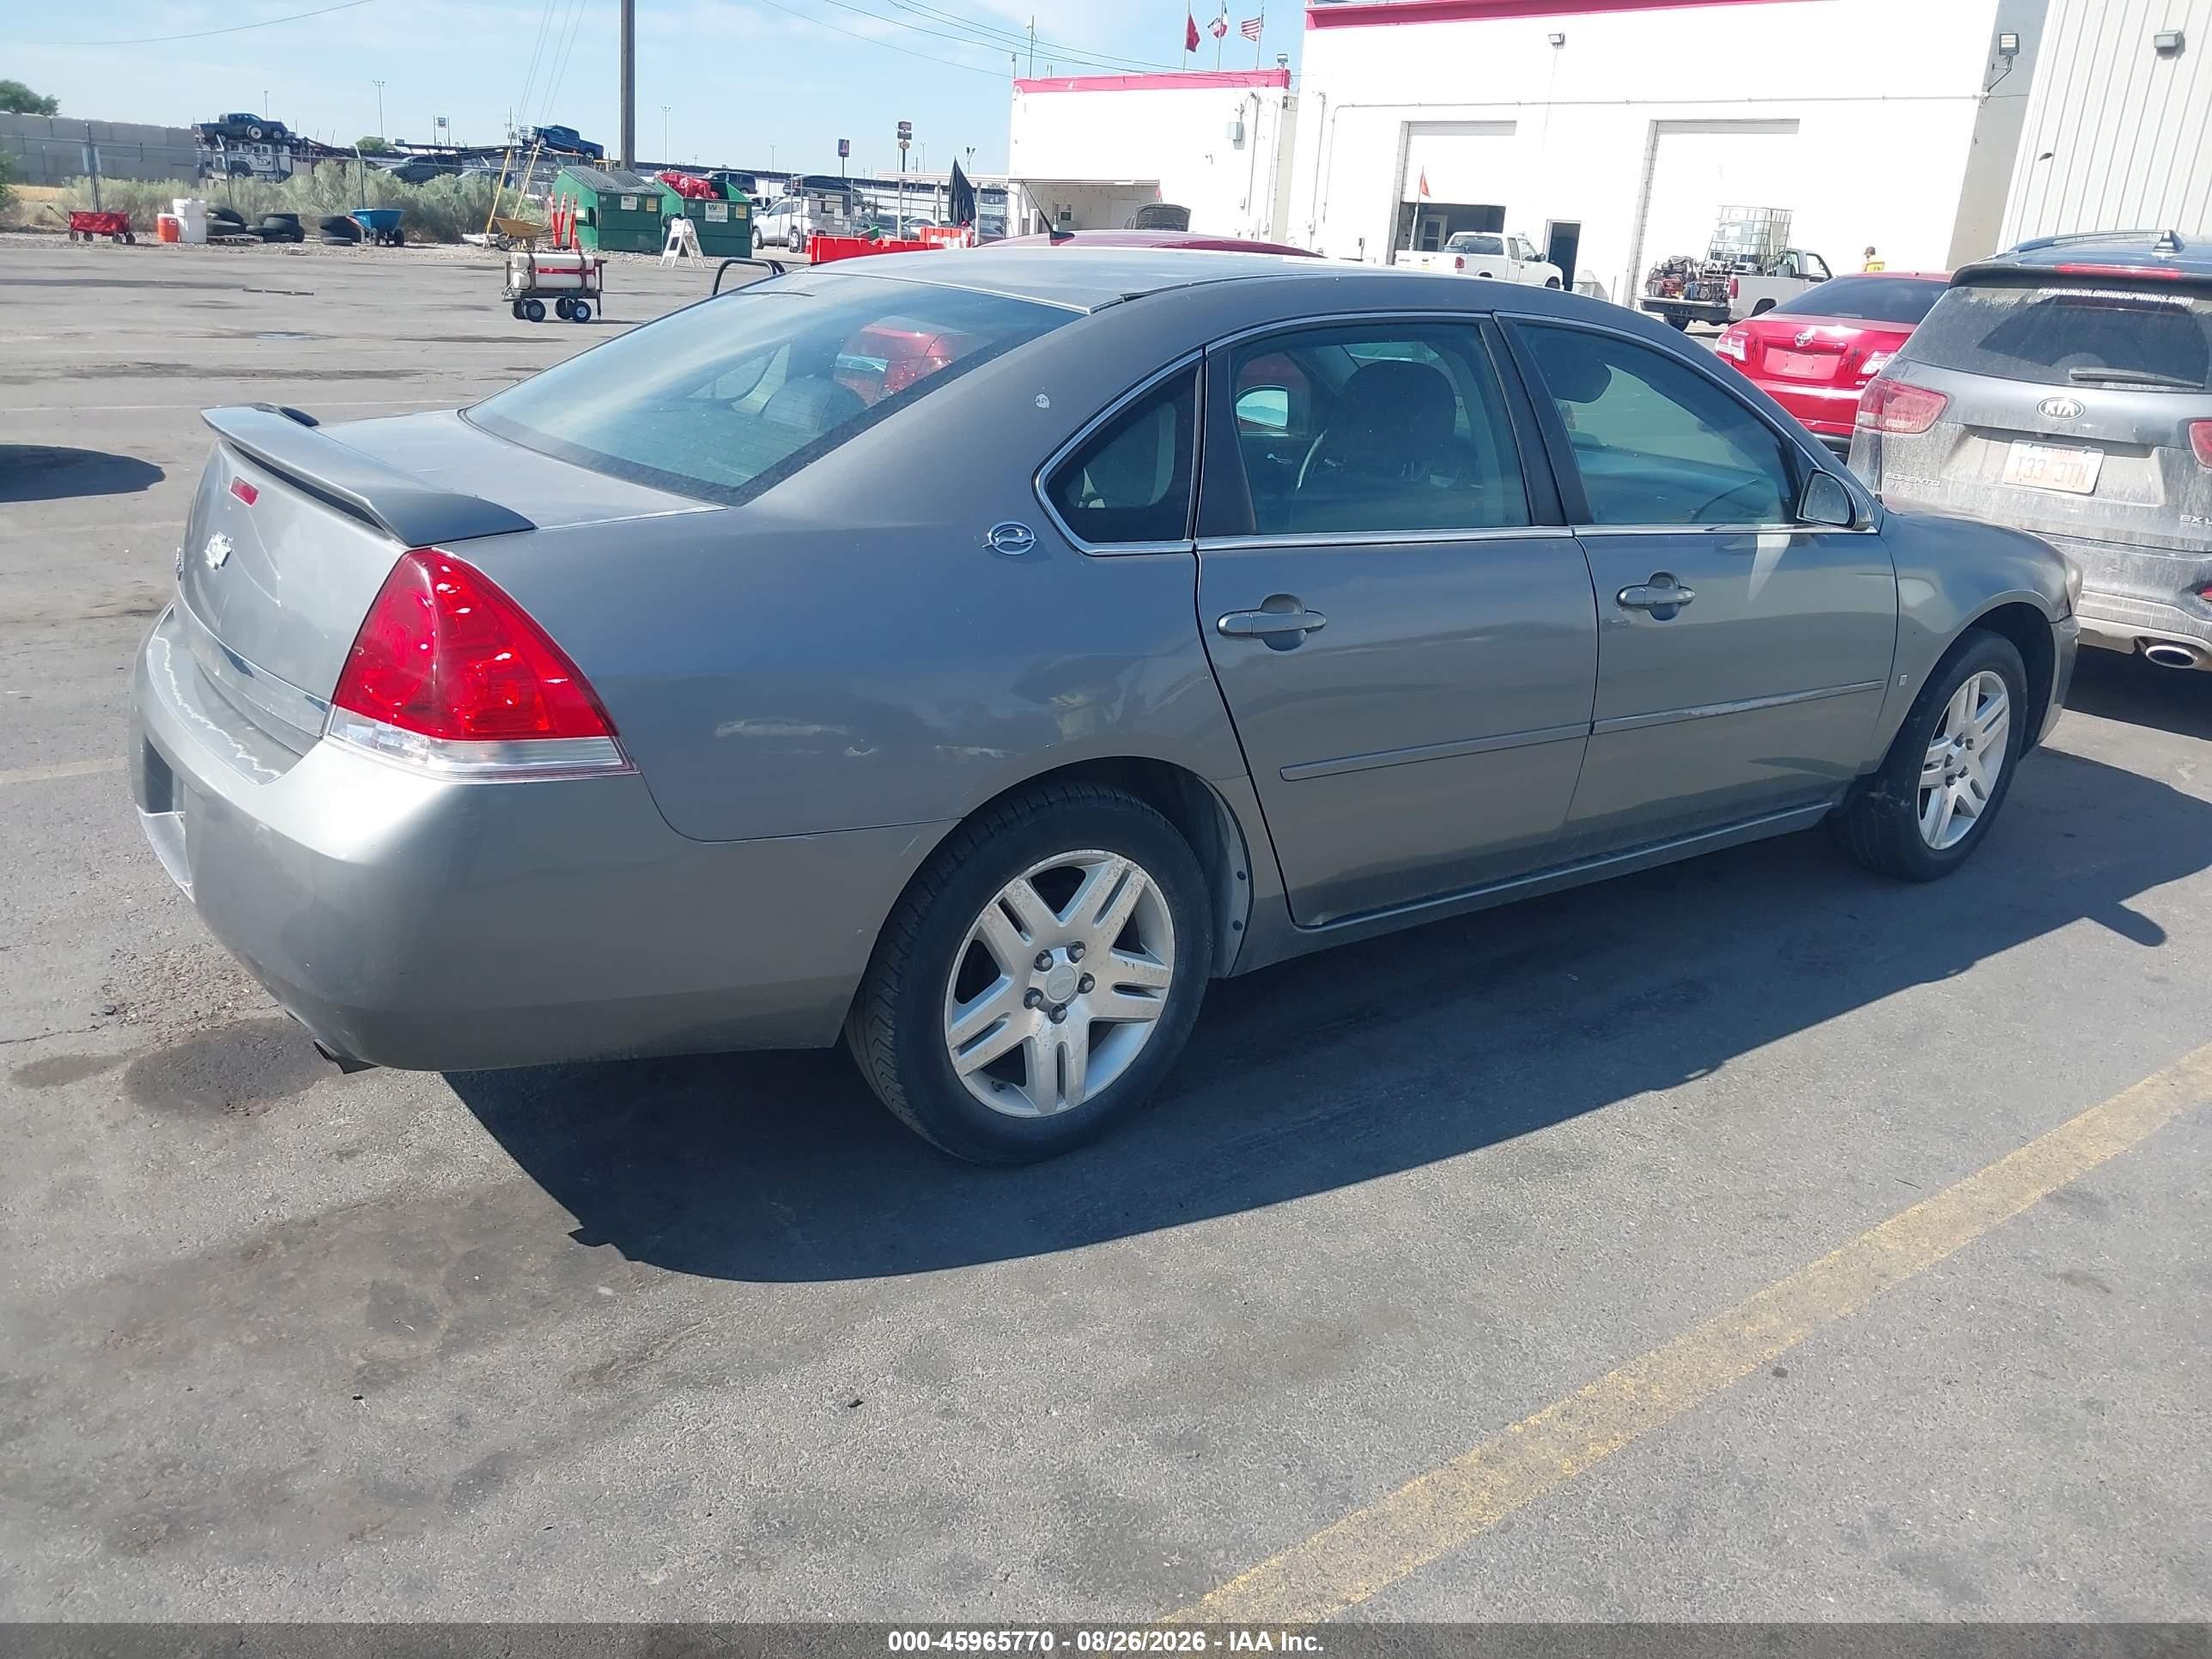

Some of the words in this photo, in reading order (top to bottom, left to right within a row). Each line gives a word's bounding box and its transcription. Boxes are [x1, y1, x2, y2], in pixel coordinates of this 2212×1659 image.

[2044, 401, 2076, 418] KIA
[1885, 472, 1941, 488] SORENTO
[2180, 514, 2204, 524] EX
